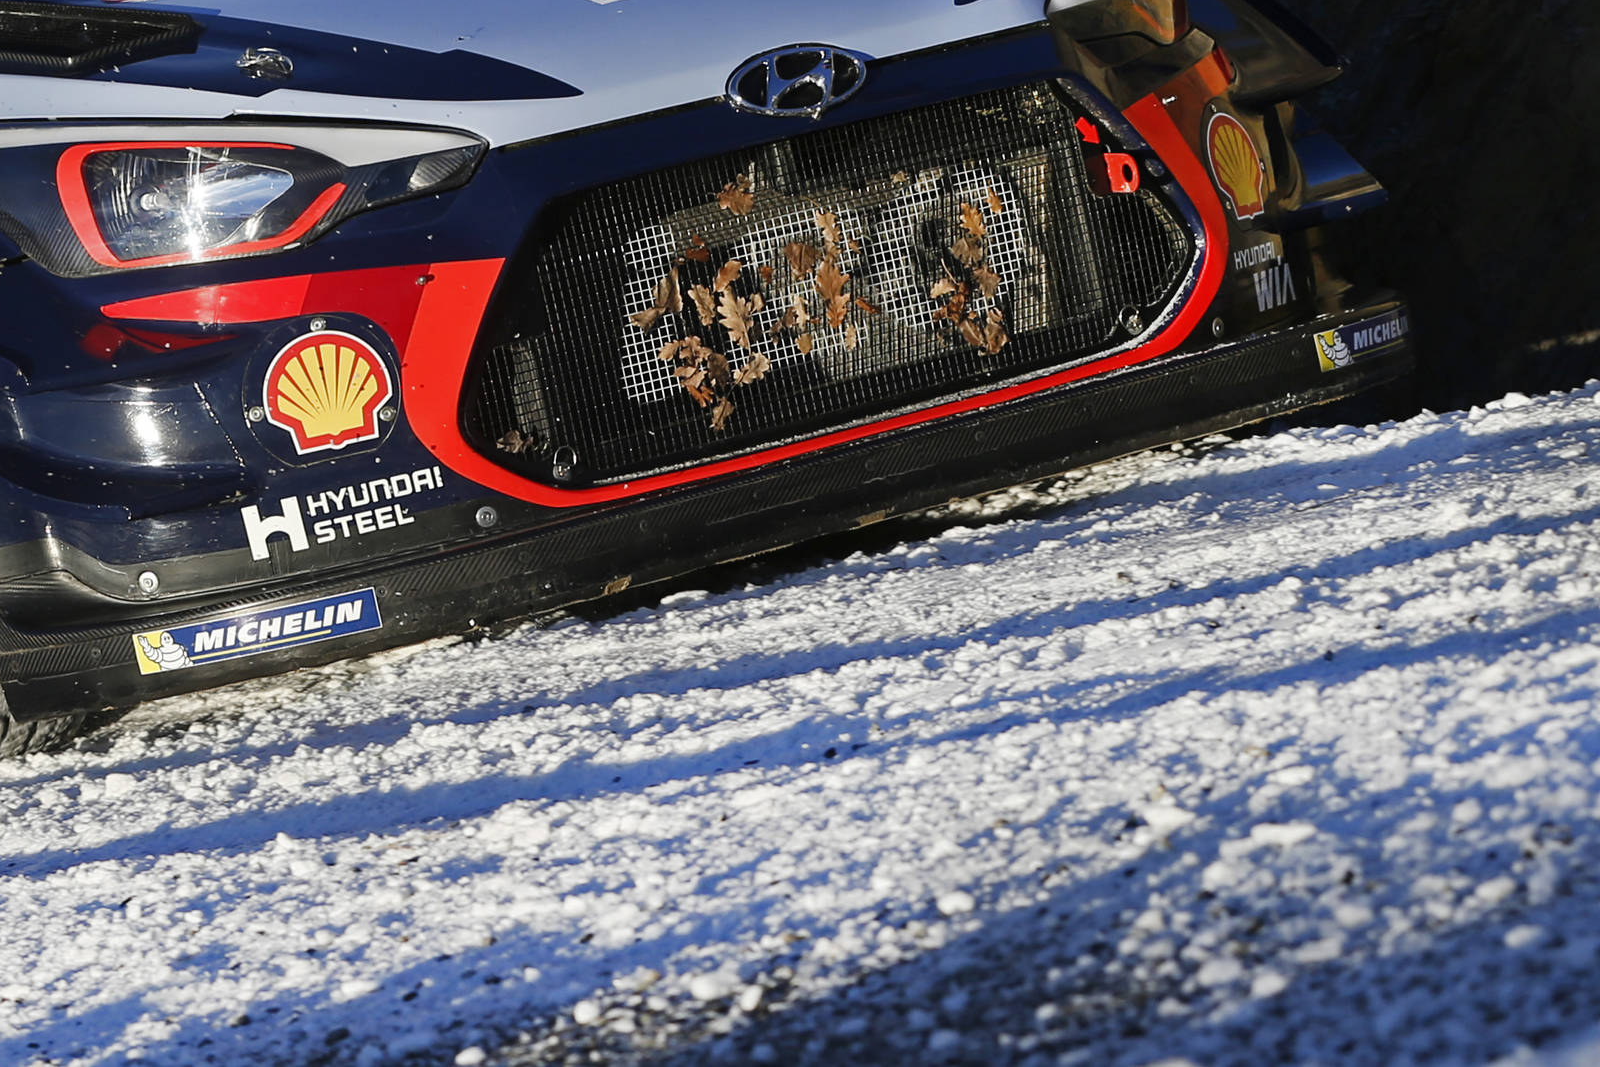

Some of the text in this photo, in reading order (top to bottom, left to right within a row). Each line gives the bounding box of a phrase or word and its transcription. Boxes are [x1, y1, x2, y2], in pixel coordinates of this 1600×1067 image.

[1233, 240, 1276, 271] HYUNDAI
[306, 465, 444, 518] HYUNDAI
[313, 504, 415, 544] STEEL
[193, 598, 363, 654] MICHELIN
